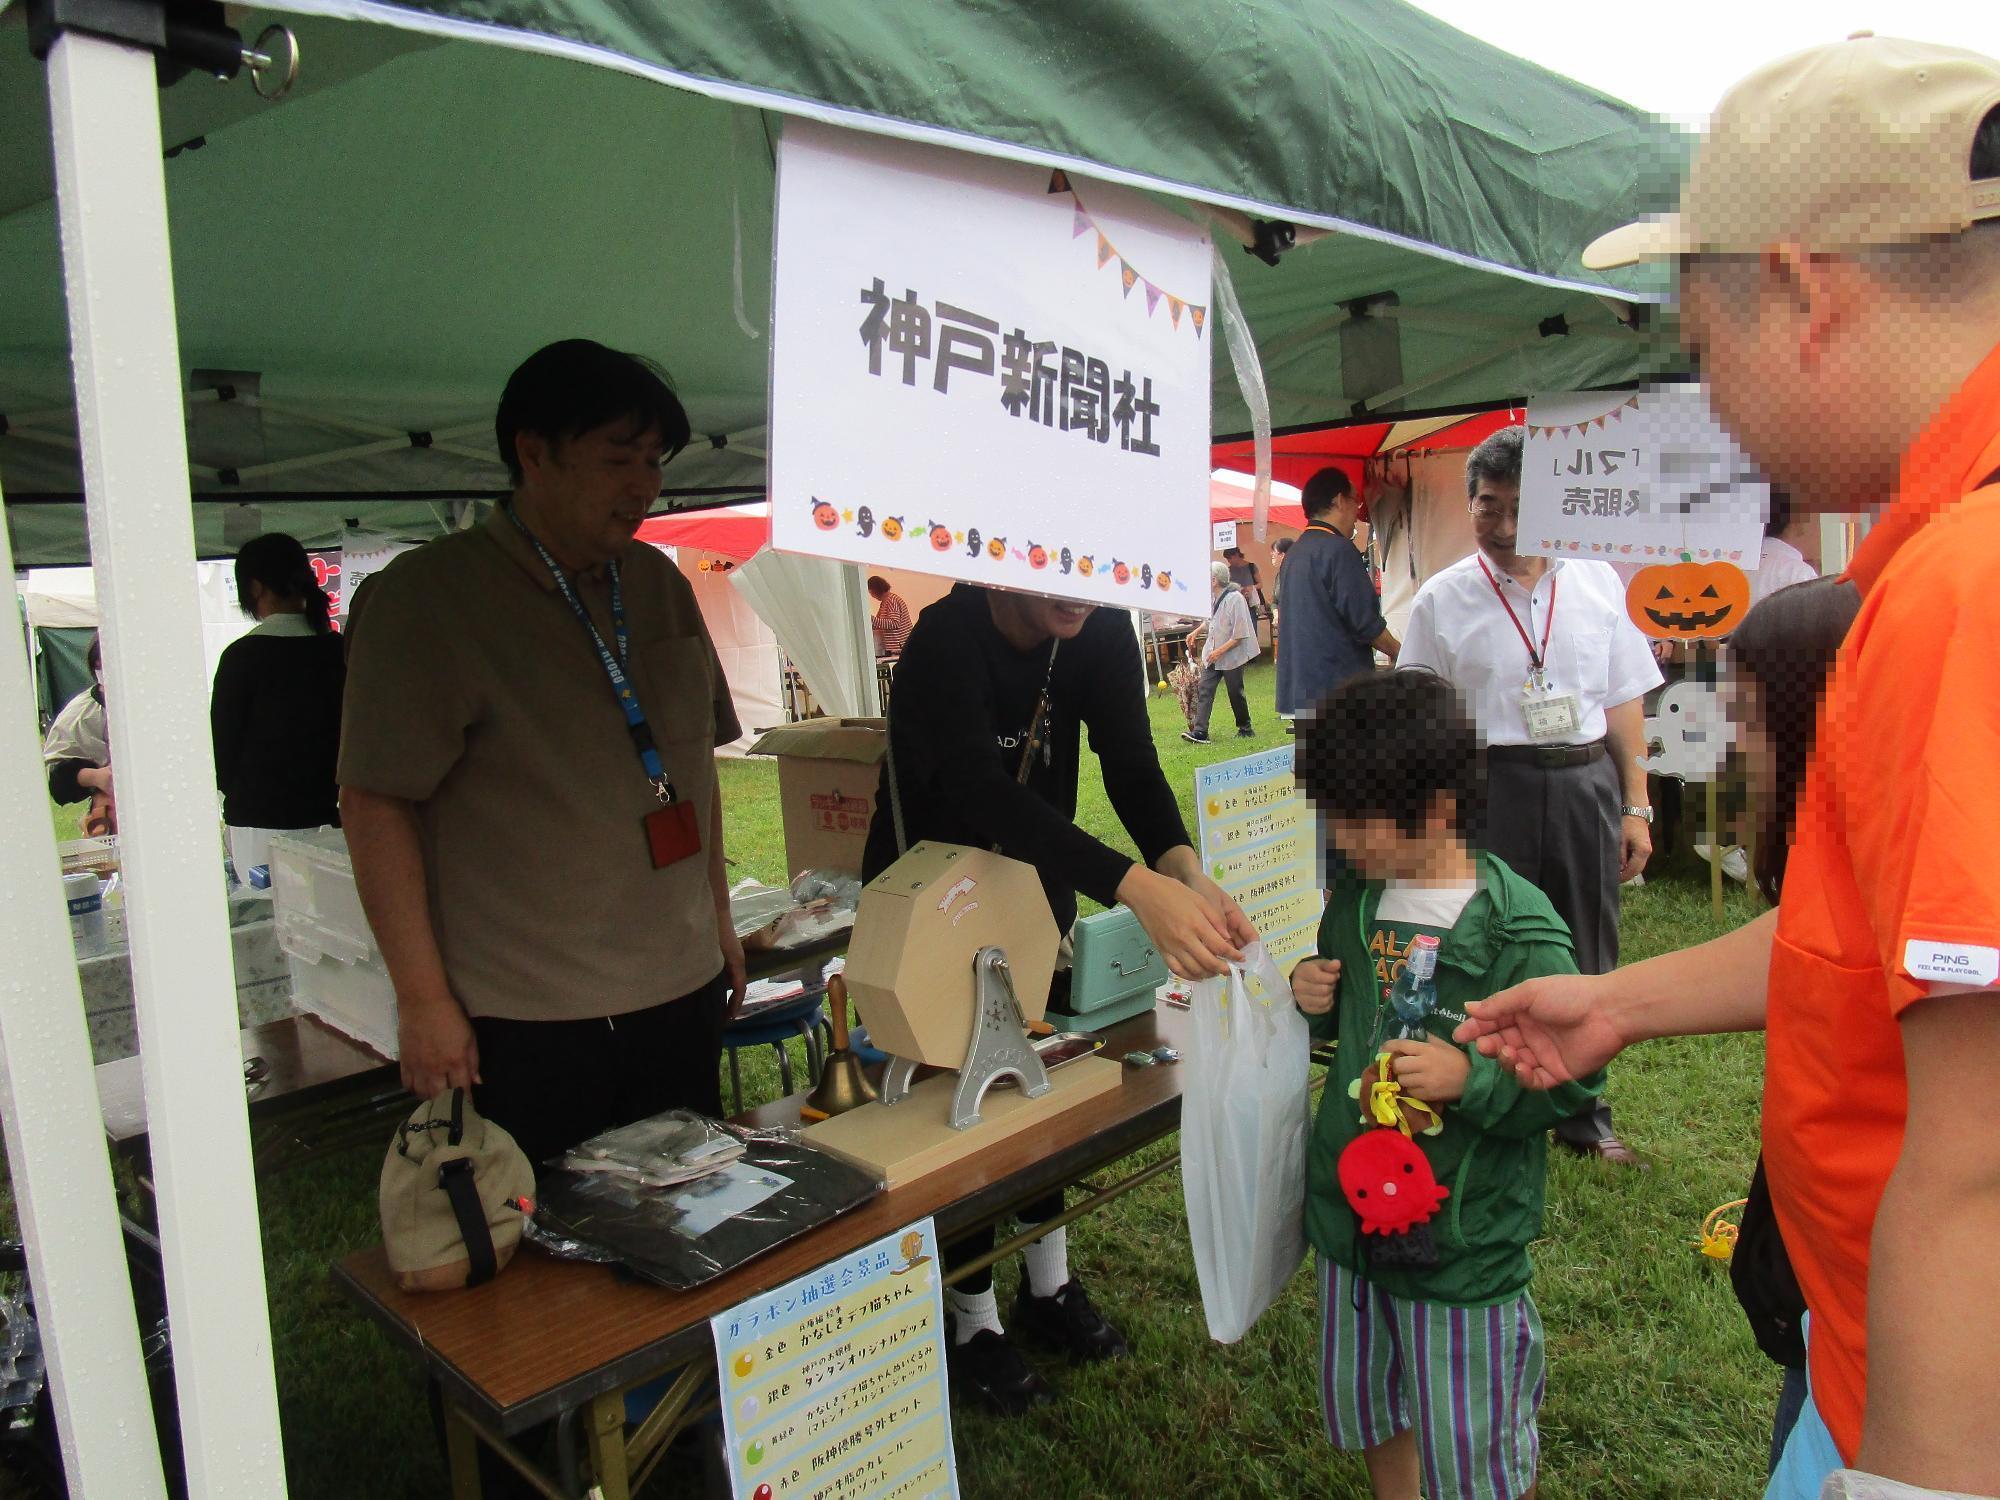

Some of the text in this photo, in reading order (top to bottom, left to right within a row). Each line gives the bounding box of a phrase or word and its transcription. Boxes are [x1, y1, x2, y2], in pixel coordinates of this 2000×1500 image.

[859, 276, 1161, 457] 神戸新聞社
[1932, 953, 1969, 966] PING
[729, 1251, 890, 1338] ガラポン抽選会景品
[764, 1284, 914, 1361] 金色 かなしきデブ猫ちゃん
[767, 1316, 929, 1404] 銀色 タンタンオリジナルグッズ
[780, 1398, 922, 1489] 赤色 阪神優勝号外セット
